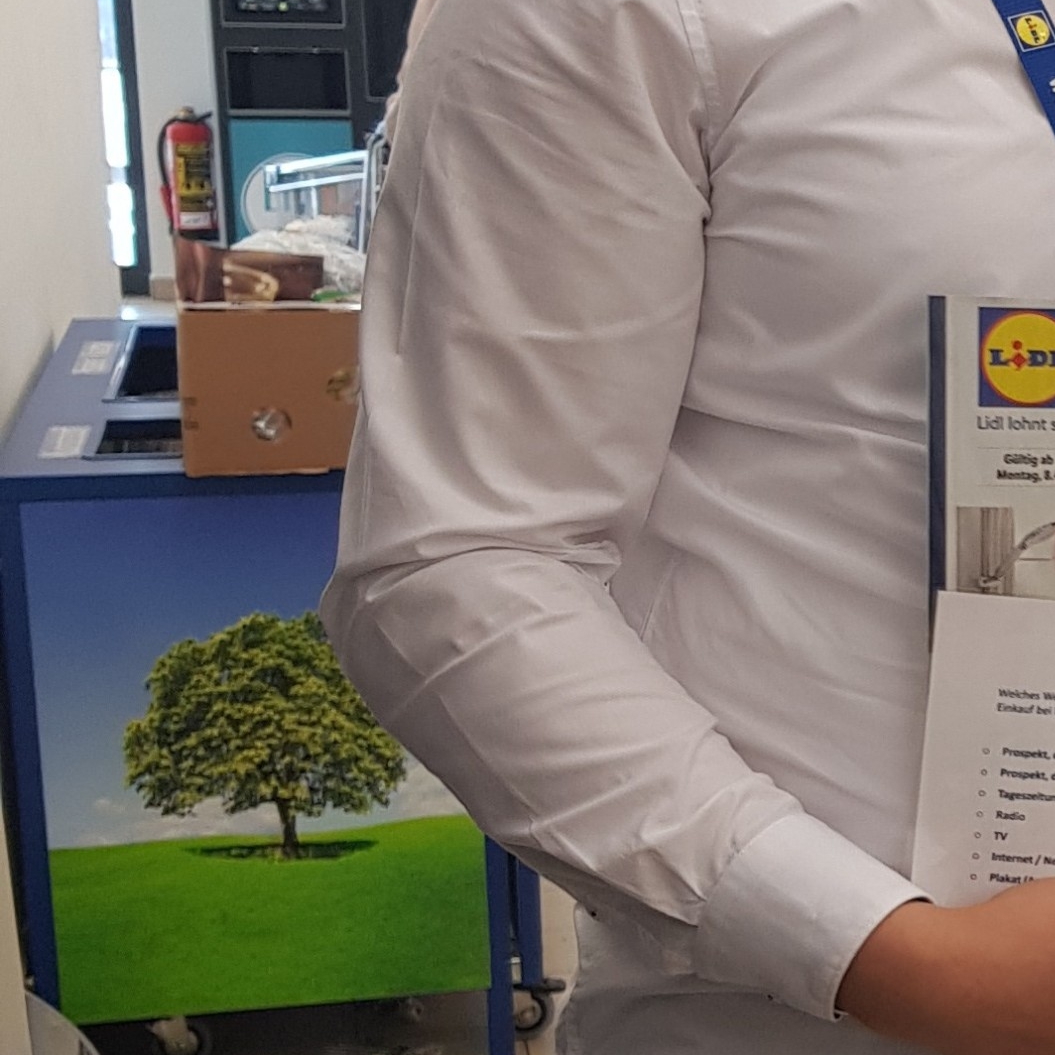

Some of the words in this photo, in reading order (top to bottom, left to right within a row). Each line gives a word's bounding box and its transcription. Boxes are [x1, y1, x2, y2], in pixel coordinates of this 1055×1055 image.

[977, 416, 1004, 431] Lidl
[1008, 416, 1046, 431] lohnt
[1003, 453, 1038, 467] Gültig
[1041, 454, 1054, 465] ab
[999, 688, 1040, 700] Welches
[997, 703, 1034, 714] Einkauf
[1036, 706, 1052, 715] bei
[1002, 747, 1051, 761] Prospekt,
[1001, 768, 1049, 781] Prospekt,
[995, 810, 1026, 822] Radio
[994, 831, 1008, 841] TV
[991, 852, 1034, 865] Internet
[990, 872, 1022, 884] Plakat
